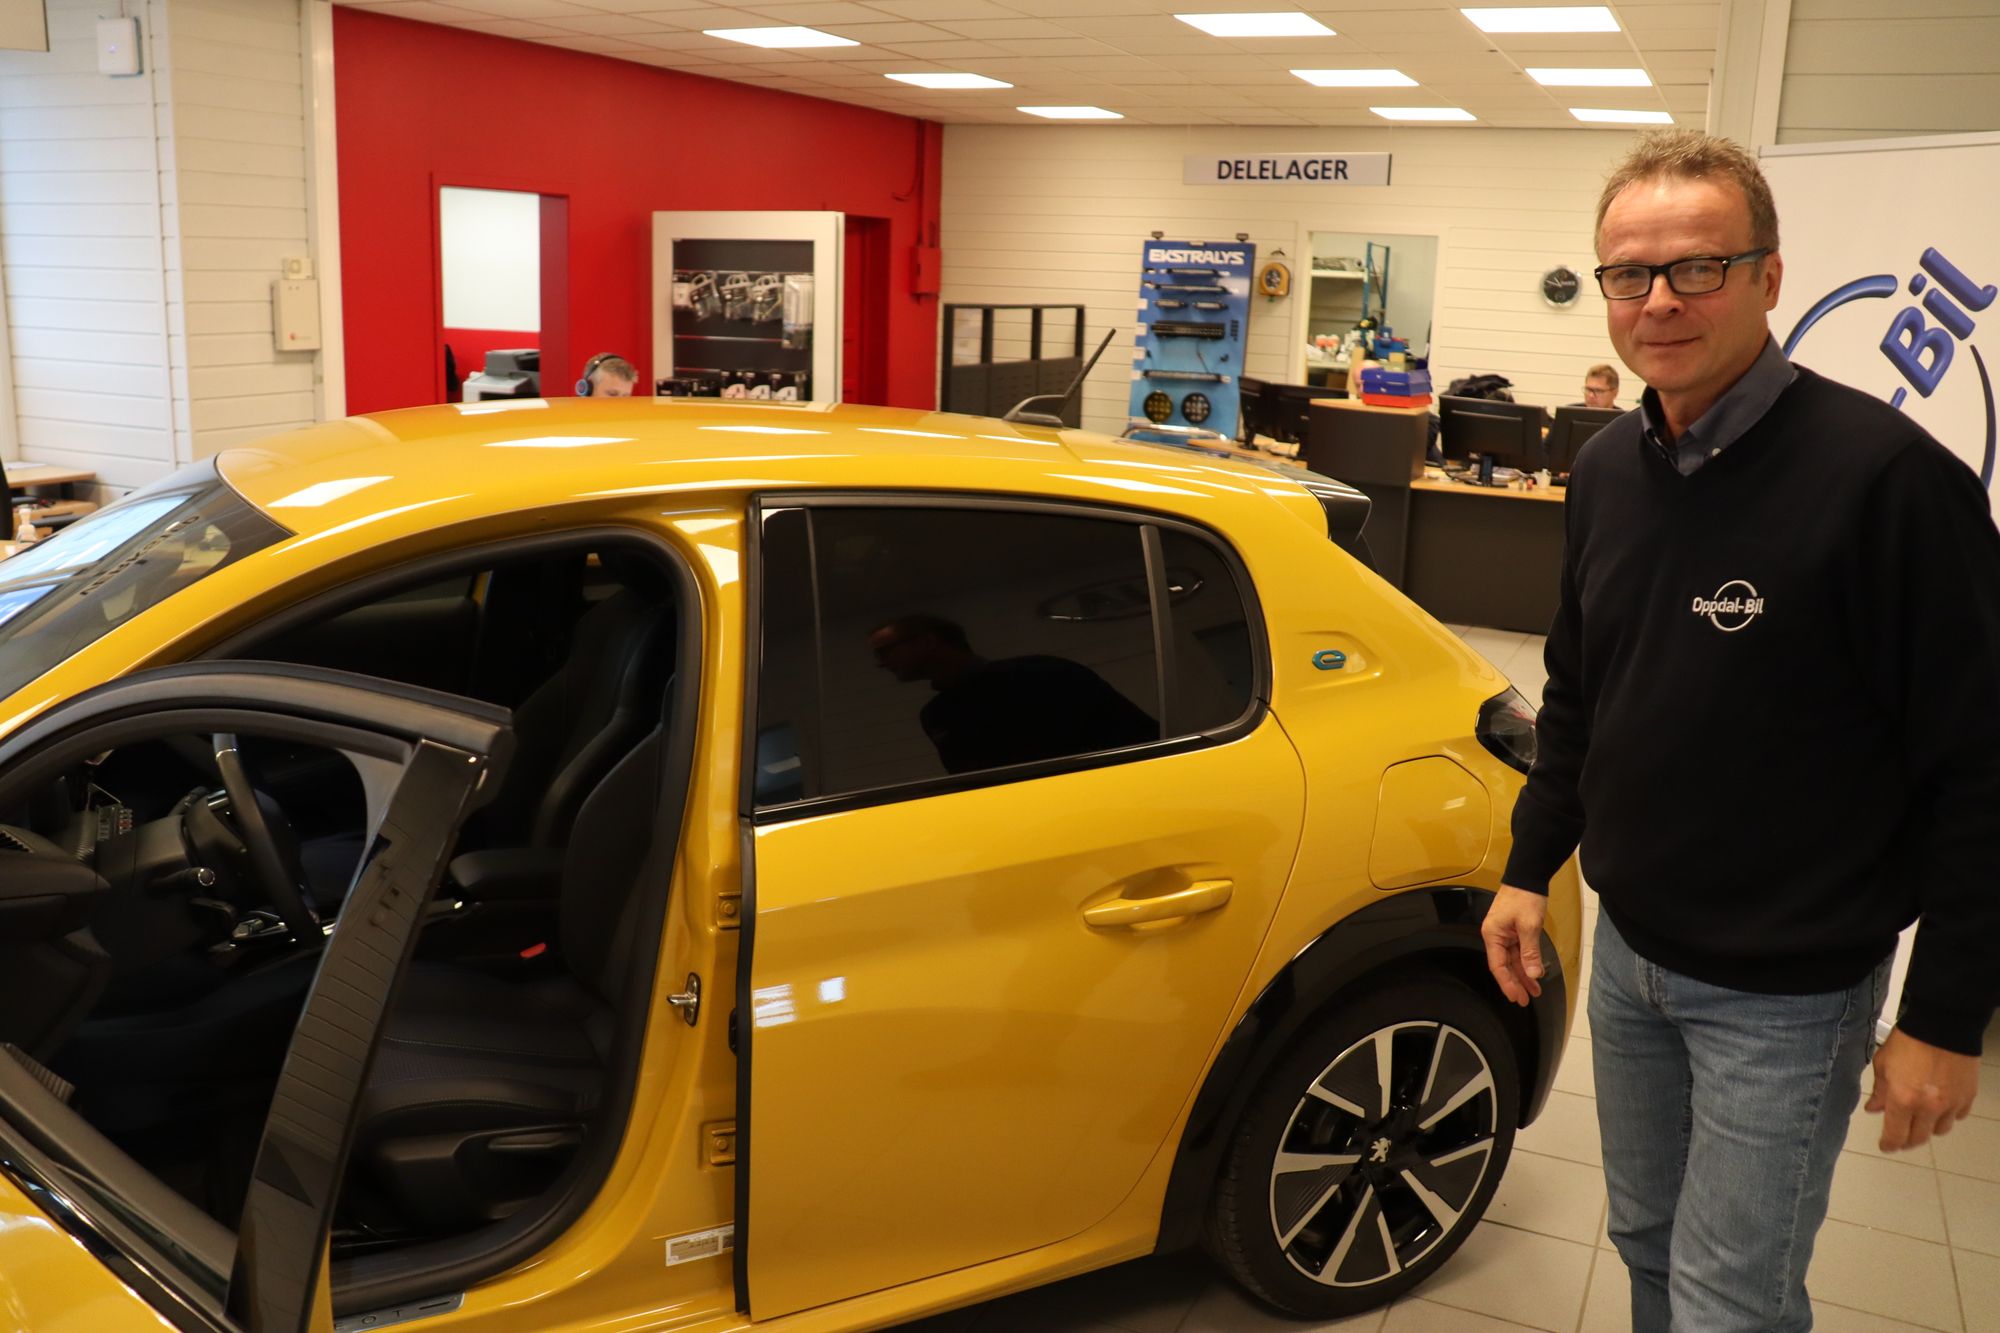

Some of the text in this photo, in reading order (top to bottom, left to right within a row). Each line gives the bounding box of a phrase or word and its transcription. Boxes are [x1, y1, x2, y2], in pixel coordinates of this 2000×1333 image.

[1217, 159, 1348, 180] DELELAGER
[1148, 248, 1246, 265] EKSTRALYS
[1691, 596, 1764, 616] Oppdal-Bil
